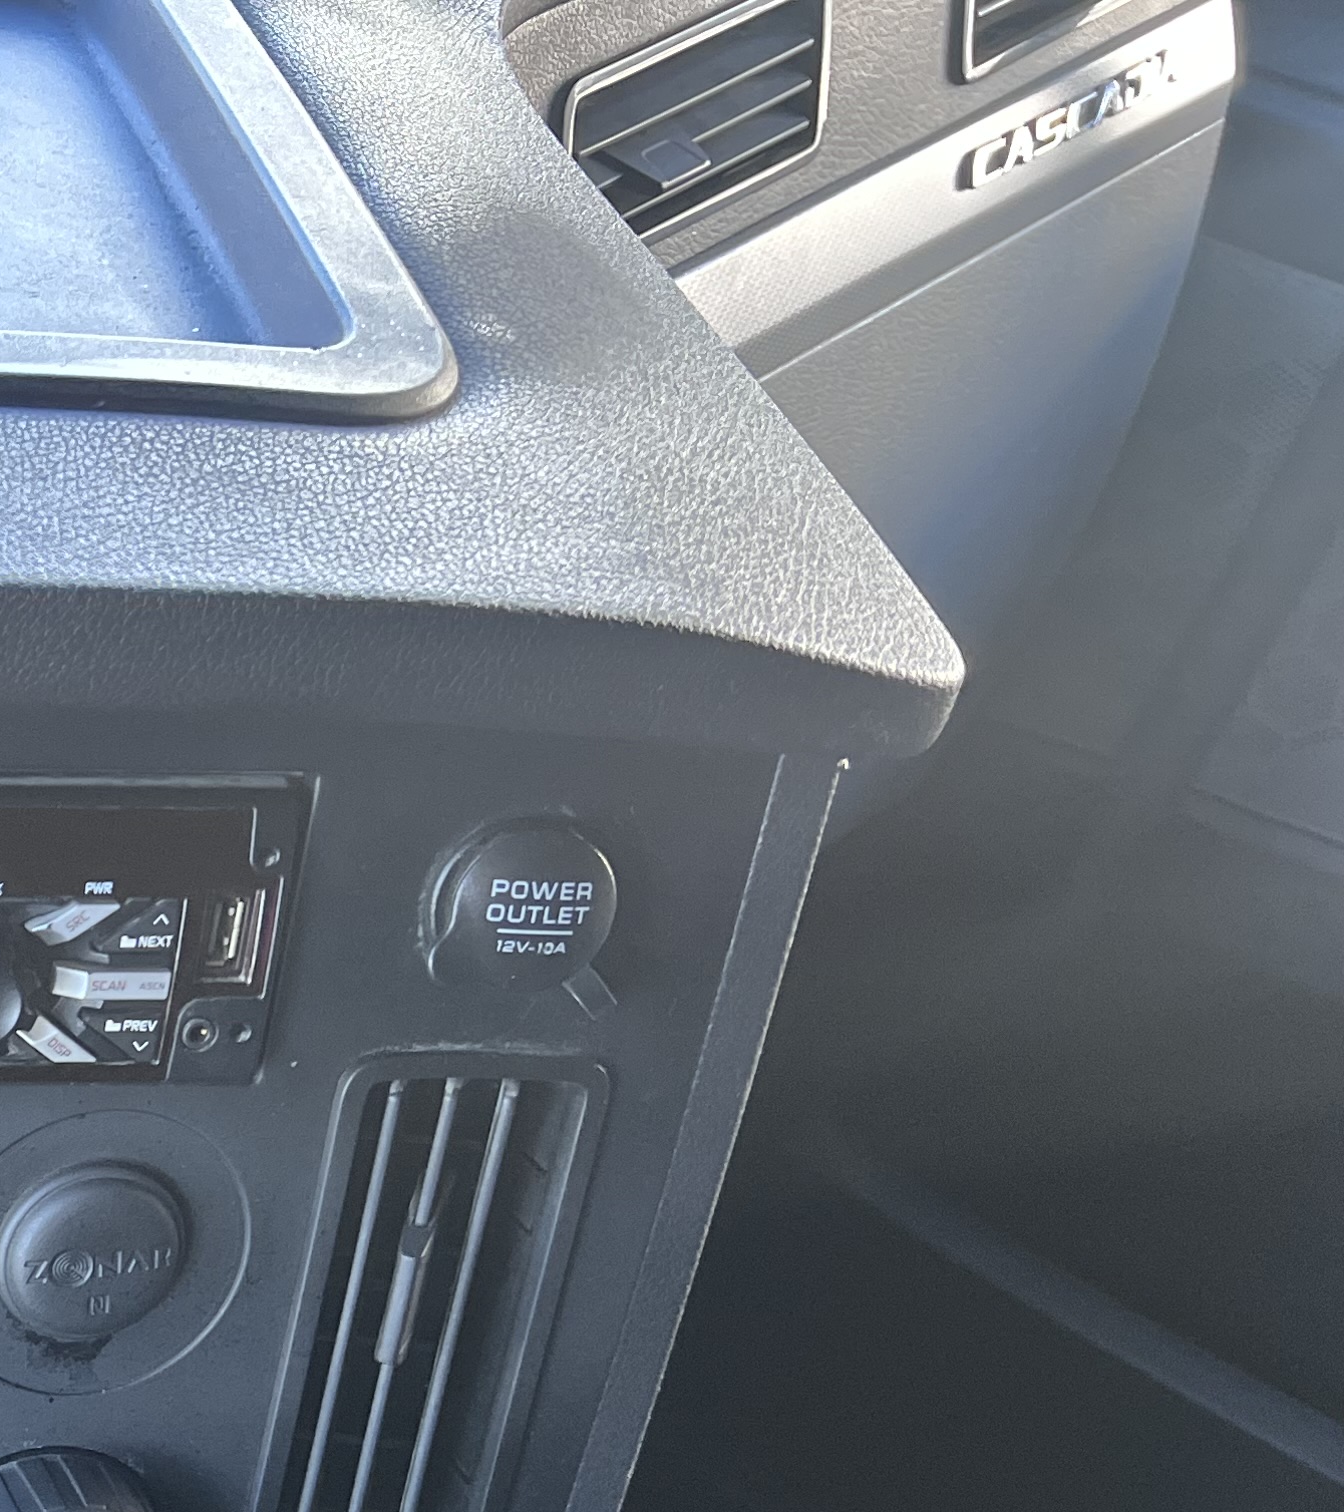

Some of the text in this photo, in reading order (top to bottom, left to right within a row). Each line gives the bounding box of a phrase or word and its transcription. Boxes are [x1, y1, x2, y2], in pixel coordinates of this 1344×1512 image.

[84, 881, 114, 895] PWR
[490, 878, 593, 901] POWER
[485, 903, 590, 925] OUTLET
[65, 914, 90, 932] SRC
[138, 935, 173, 948] NEXT
[496, 939, 566, 955] 12V-10A
[91, 980, 127, 992] SCAN
[122, 1020, 158, 1032] PREV
[47, 1037, 73, 1058] DISP
